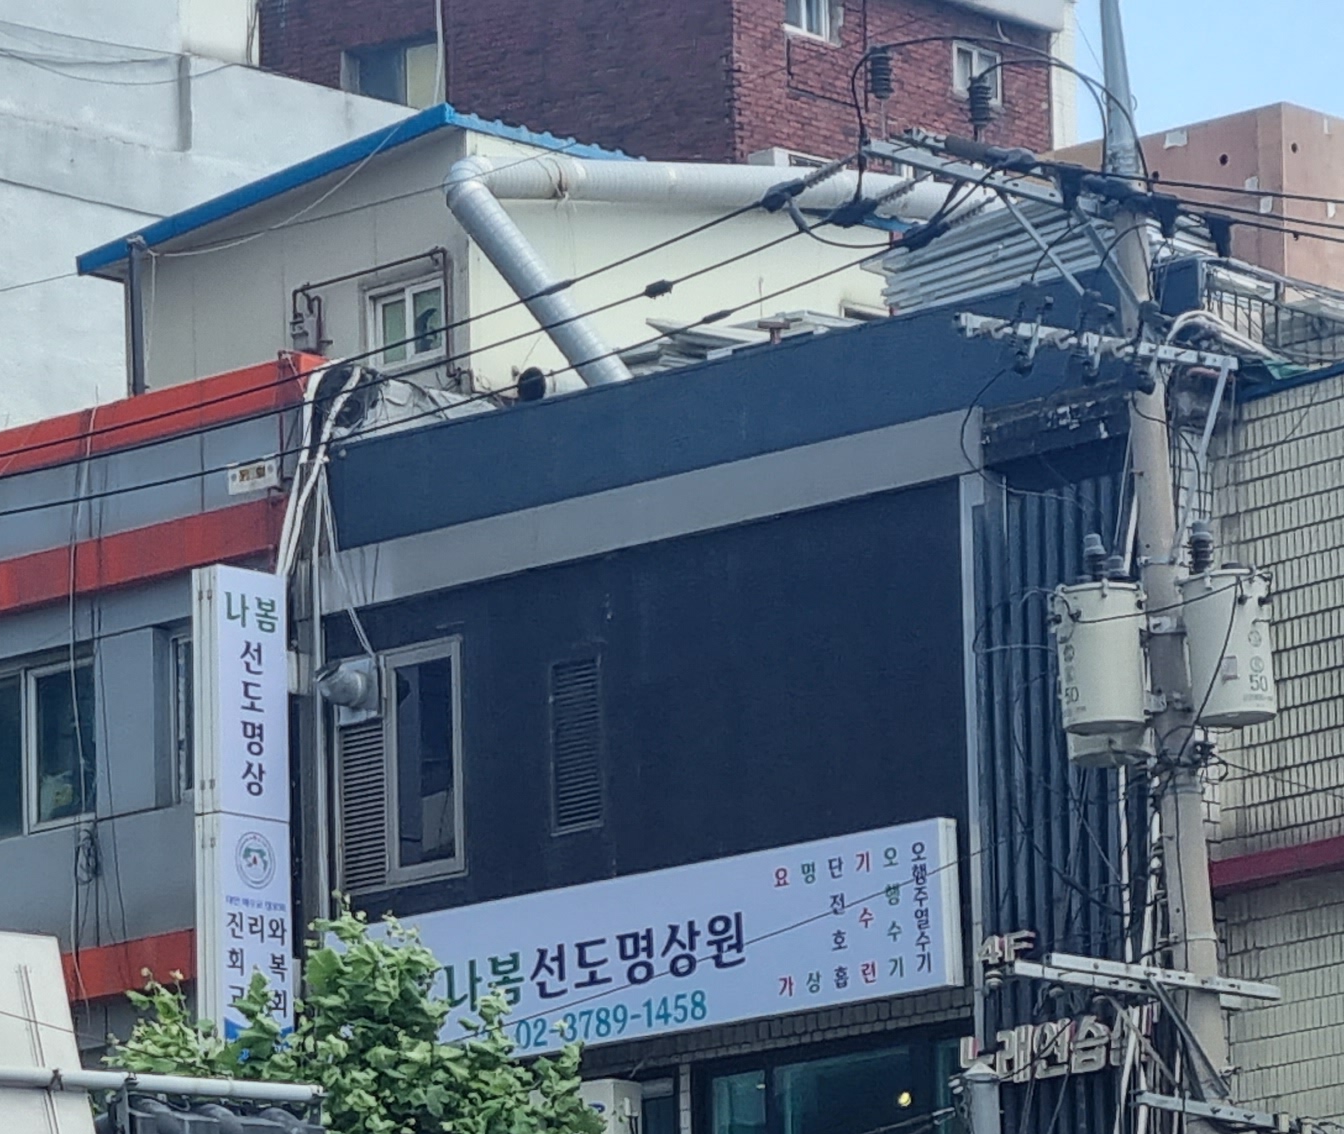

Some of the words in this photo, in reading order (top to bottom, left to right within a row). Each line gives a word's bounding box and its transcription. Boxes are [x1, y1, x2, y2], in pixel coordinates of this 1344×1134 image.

[224, 589, 280, 634] 나봄
[239, 640, 267, 798] 선도명상
[1249, 674, 1268, 692] 50
[226, 911, 287, 946] 진리와
[774, 866, 795, 998] 요가
[800, 860, 822, 994] 명상
[827, 855, 850, 990] 단전호흡
[883, 846, 904, 978] 오행수기
[910, 840, 933, 973] 오행주열수기
[976, 930, 1036, 965] 4F
[516, 989, 708, 1050] 02-3789-1458
